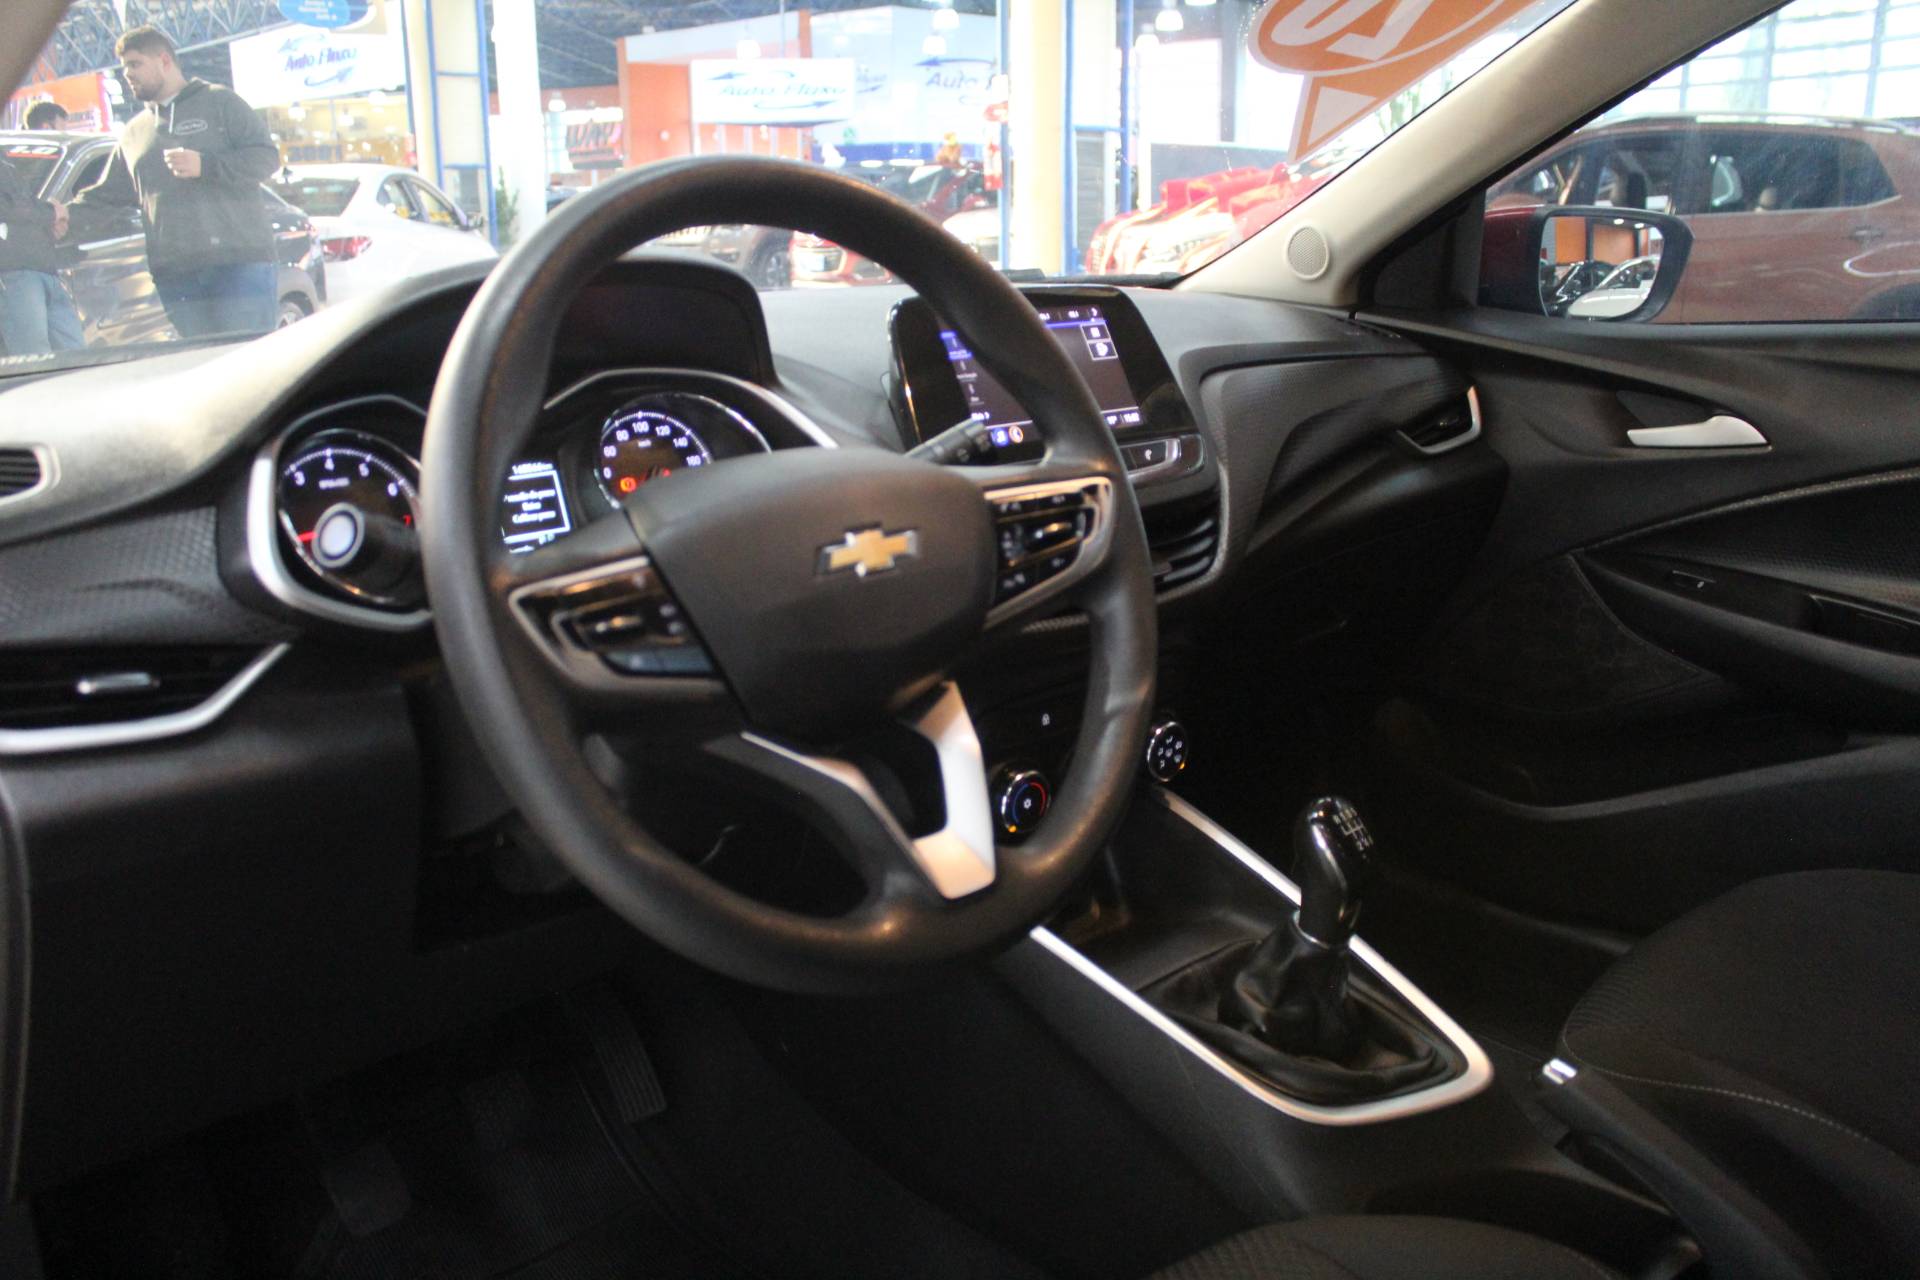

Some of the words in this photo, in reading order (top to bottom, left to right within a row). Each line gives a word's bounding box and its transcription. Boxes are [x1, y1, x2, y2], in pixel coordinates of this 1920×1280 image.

[926, 70, 978, 89] Auto
[719, 85, 775, 96] Auto
[784, 83, 846, 96] Fluxo
[632, 421, 649, 433] 100
[655, 425, 671, 436] 120
[616, 429, 629, 441] 80
[673, 437, 689, 448] 140
[604, 445, 616, 457] 60
[325, 458, 334, 471] 4
[359, 463, 369, 476] 5
[294, 472, 304, 485] 3
[388, 483, 398, 496] 6
[403, 514, 411, 526] 7
